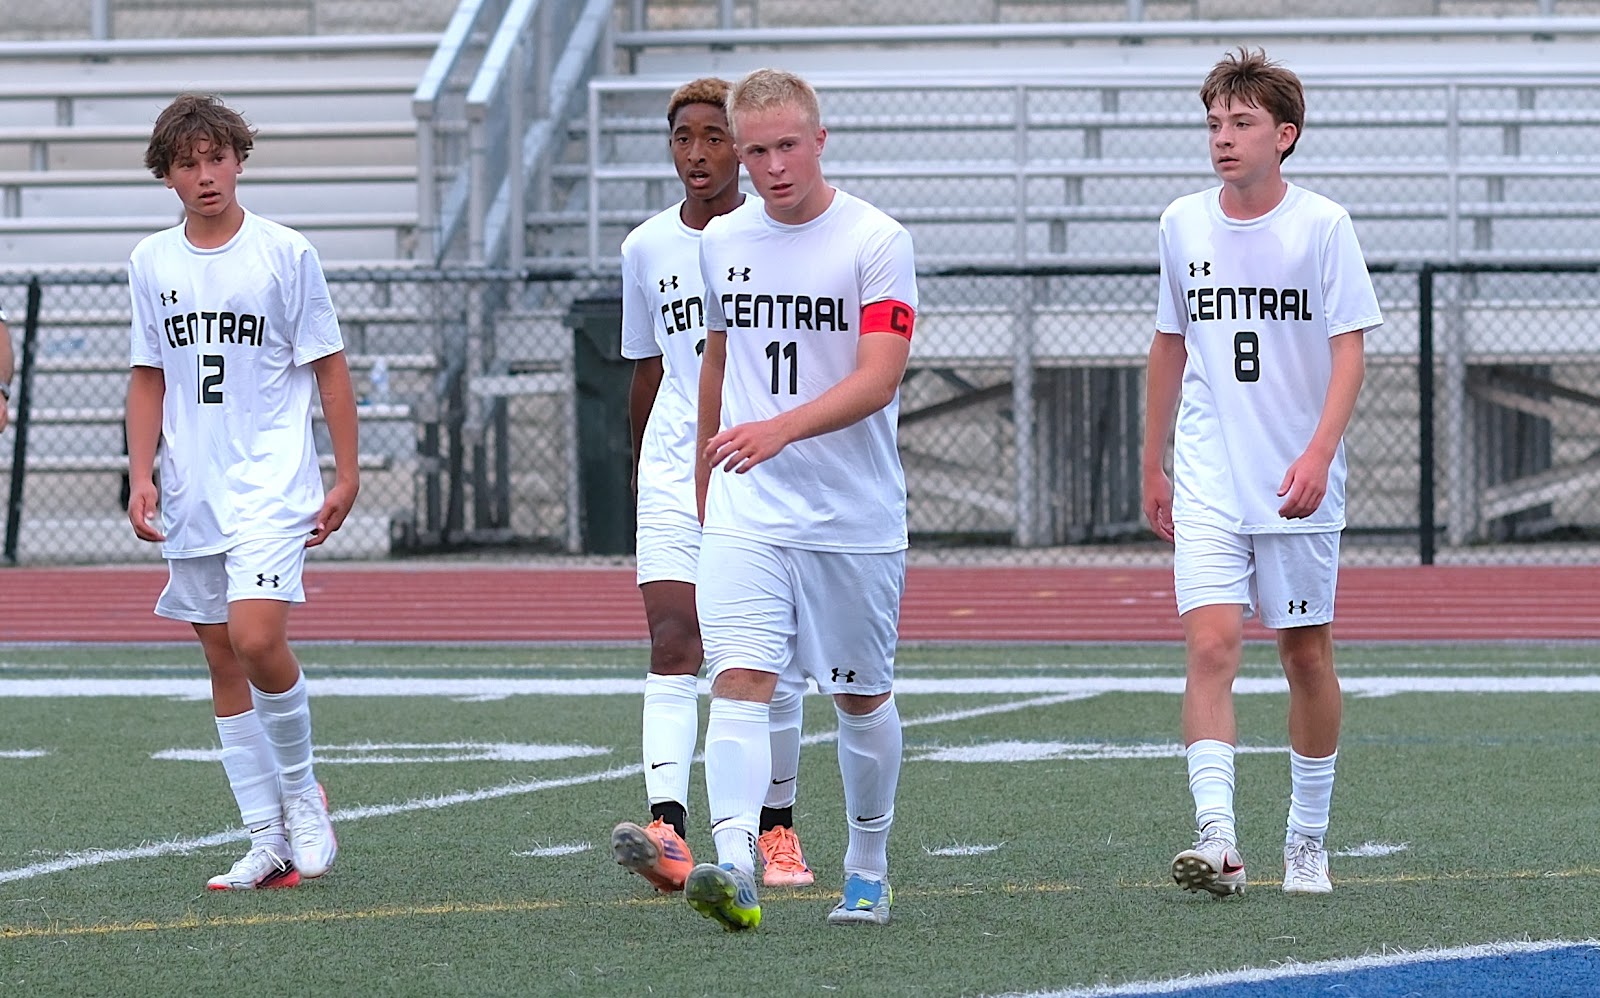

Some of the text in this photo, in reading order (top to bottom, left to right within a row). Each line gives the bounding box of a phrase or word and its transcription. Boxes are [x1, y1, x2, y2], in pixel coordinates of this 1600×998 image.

[661, 296, 704, 336] CEN
[721, 293, 848, 332] CENTRAL
[890, 305, 909, 333] C
[1187, 287, 1312, 322] CENTRAL
[765, 341, 798, 395] 11
[1234, 331, 1260, 382] 8
[197, 354, 224, 404] 2
